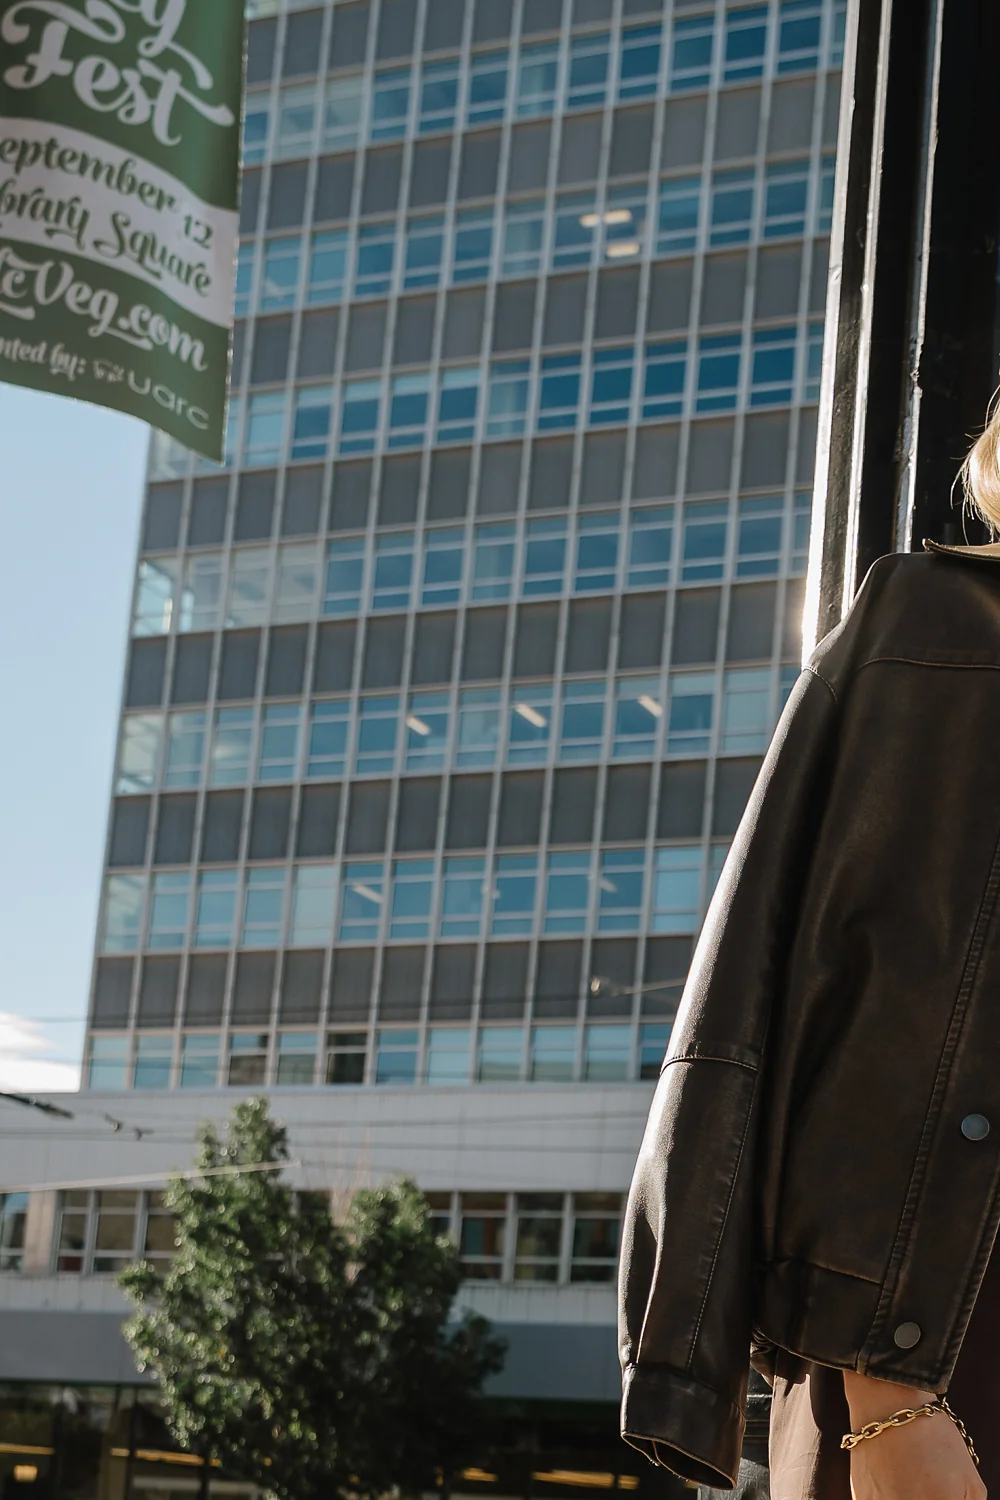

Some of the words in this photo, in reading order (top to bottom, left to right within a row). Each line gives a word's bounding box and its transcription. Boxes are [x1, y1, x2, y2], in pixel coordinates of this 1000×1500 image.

[2, 0, 235, 147] Fest
[0, 246, 209, 372] cVeg.com
[93, 210, 211, 297] Square
